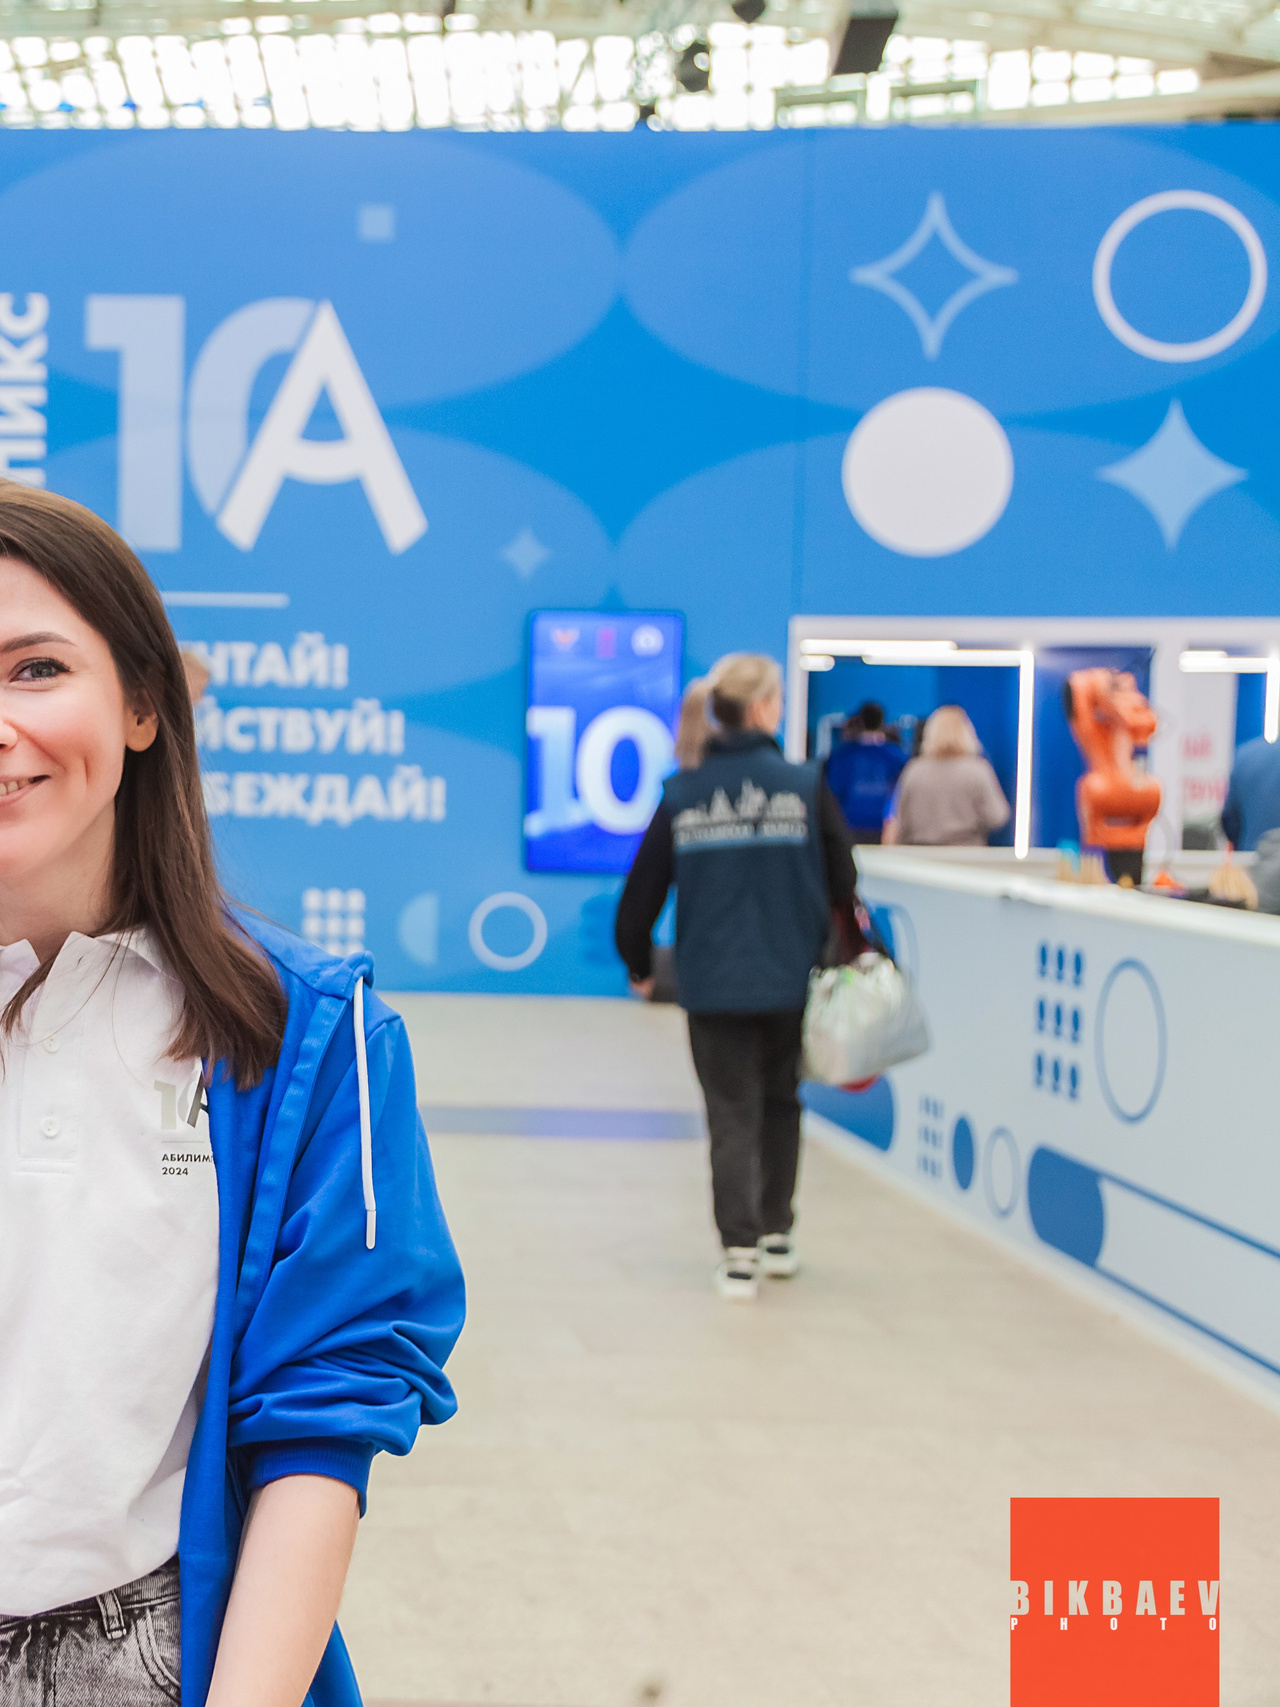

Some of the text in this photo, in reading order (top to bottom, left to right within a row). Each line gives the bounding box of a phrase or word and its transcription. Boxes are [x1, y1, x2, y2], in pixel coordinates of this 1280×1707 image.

[195, 697, 406, 756] ЙСТВУЙ!
[202, 764, 447, 827] БЕЖДАЙ!
[524, 705, 680, 836] 10
[162, 1153, 213, 1163] АБИЛИМ
[162, 1167, 189, 1176] 2024
